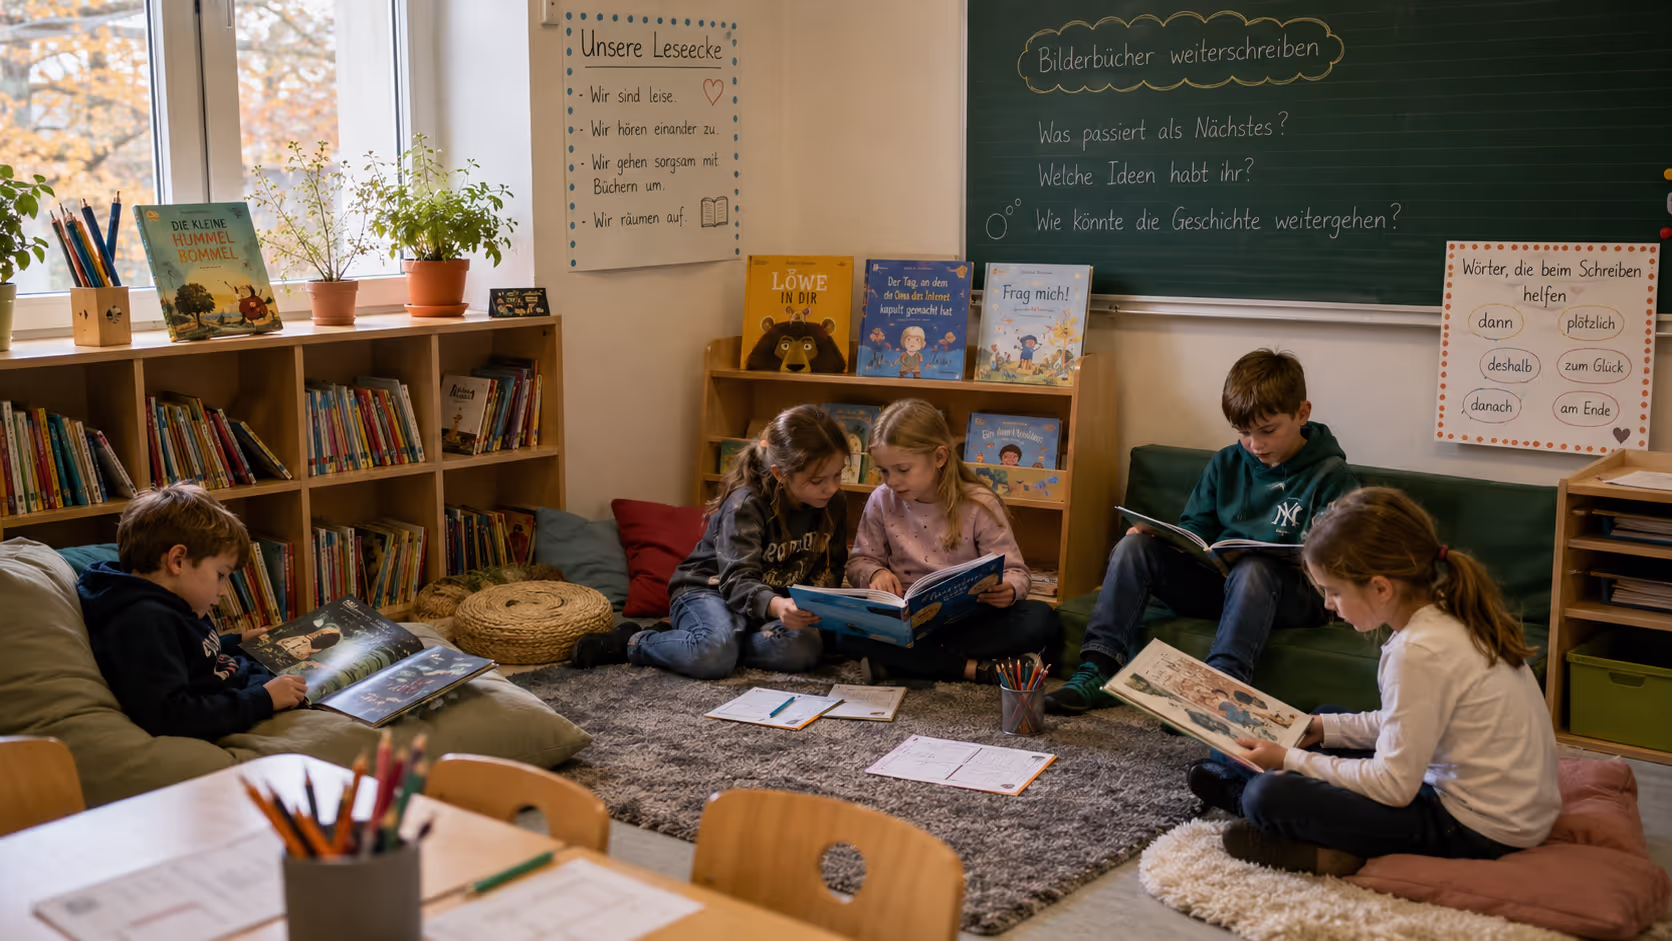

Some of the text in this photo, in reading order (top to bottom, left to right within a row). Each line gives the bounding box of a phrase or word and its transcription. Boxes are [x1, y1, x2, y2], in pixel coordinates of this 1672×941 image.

[581, 29, 723, 60] Unsere Leseecke
[1038, 33, 1319, 73] Bilderbücher weiterschreiben
[590, 85, 610, 103] Wir
[618, 87, 641, 103] sind
[649, 85, 677, 103] leise.
[591, 120, 611, 137] Wir
[618, 120, 647, 135] hören
[654, 120, 697, 135] einander
[703, 125, 719, 135] zu.
[1038, 121, 1071, 145] Was
[1082, 120, 1146, 151] passiert
[1158, 117, 1183, 140] als
[591, 153, 610, 170] Wir
[617, 153, 648, 176] gehen
[654, 155, 696, 174] sorgsam
[703, 152, 719, 167] mit
[1038, 157, 1255, 187] Welche Ideen habt ihr?
[593, 178, 665, 195] Büchern um.
[171, 219, 227, 231] DIE KLEINE
[593, 211, 613, 228] Wir
[620, 211, 659, 226] räumen
[666, 206, 687, 227] auf.
[1036, 202, 1402, 239] Wie könnte die Geschichte weitergehen?
[173, 231, 235, 247] HUMMEL
[178, 247, 239, 263] BOMMEL
[1463, 258, 1642, 278] Wörter, die beim Schreiben
[888, 276, 901, 287] Der
[920, 279, 930, 287] an
[932, 277, 948, 287] dem
[781, 291, 817, 305] IN DIR
[1002, 284, 1070, 305] Frag mich!
[1523, 285, 1567, 309] helfen
[880, 304, 953, 317] kaputt gemacht hat
[1478, 312, 1513, 329] dann
[1566, 315, 1616, 334] plötzlich
[1487, 356, 1532, 373] deshalb
[1564, 357, 1624, 374] zum Glück
[1470, 396, 1513, 413] danach
[1560, 401, 1611, 416] am Ende
